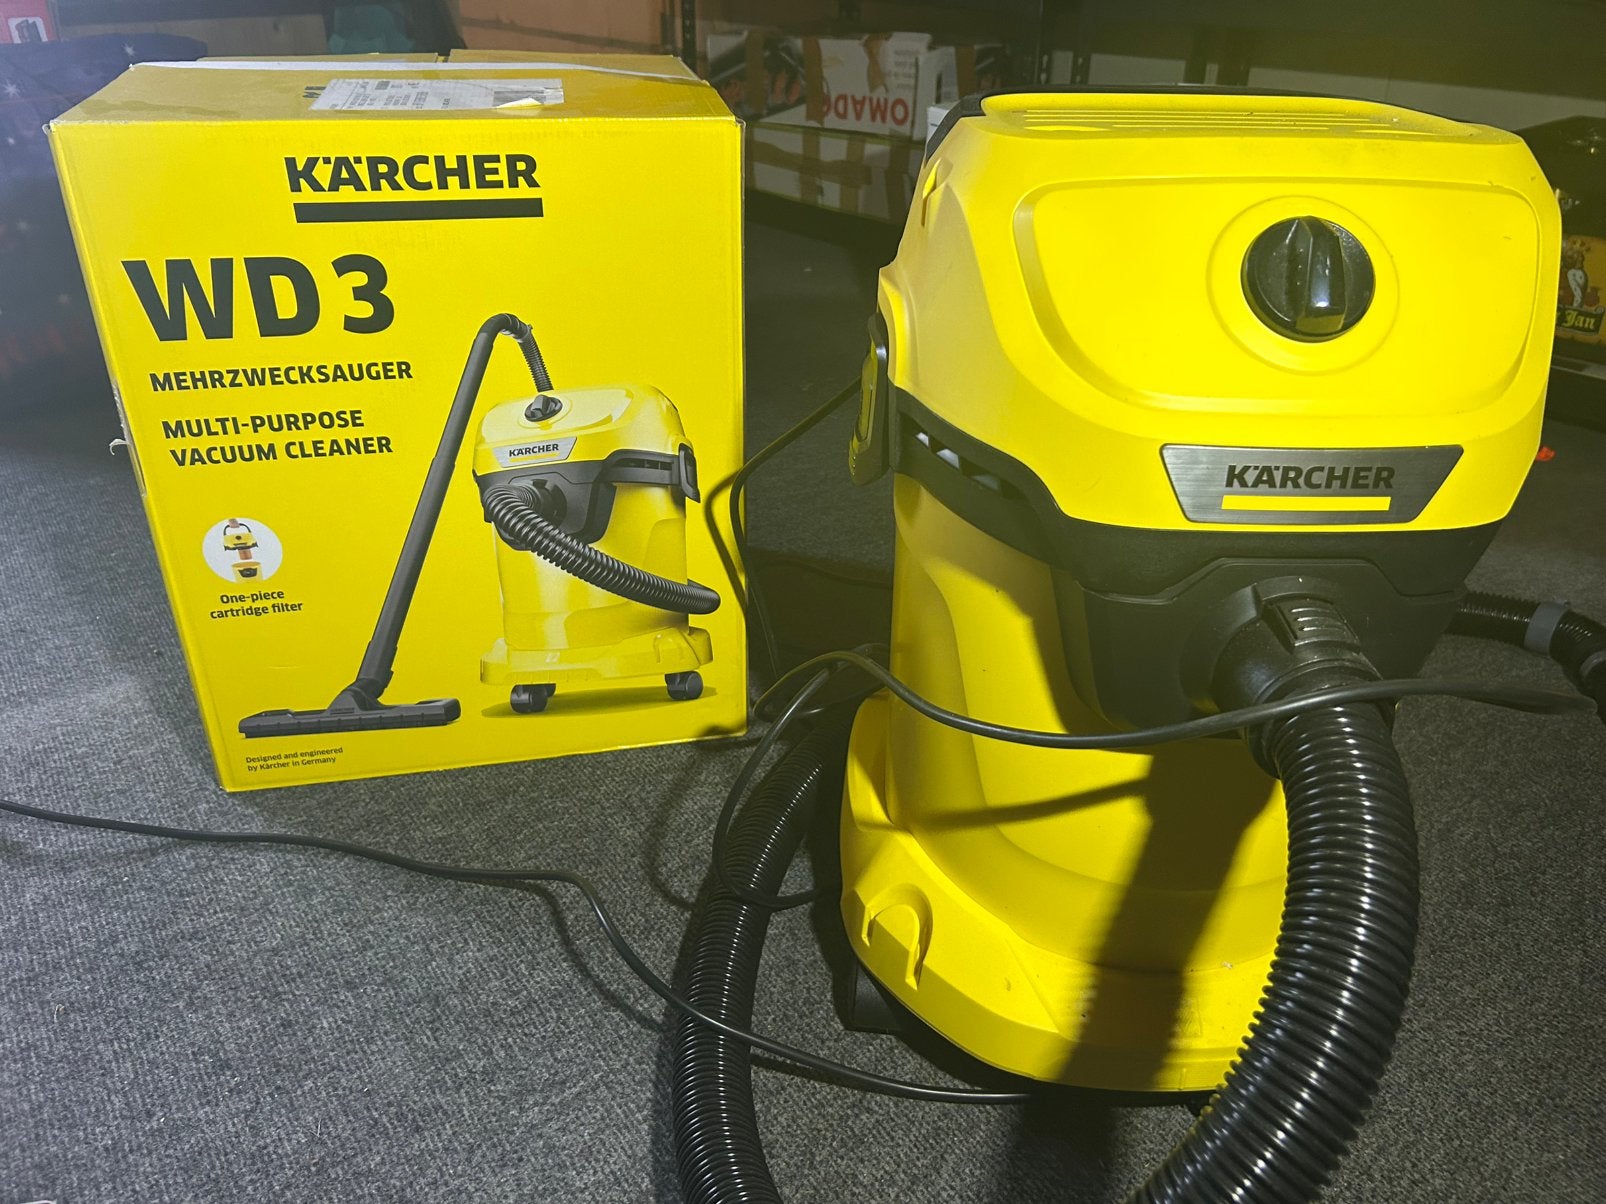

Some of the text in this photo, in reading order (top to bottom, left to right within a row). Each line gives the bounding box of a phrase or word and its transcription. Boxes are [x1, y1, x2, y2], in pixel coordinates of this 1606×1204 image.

[285, 154, 540, 193] KÄRCHER
[121, 253, 395, 342] WD 3
[1562, 310, 1595, 329] Jan
[149, 361, 413, 392] MEHRZWECKSAUGER
[162, 409, 365, 439] MULTI-PURPOSE
[170, 436, 393, 467] VACUUM CLEANER
[509, 443, 559, 457] KÄRCHER
[1225, 463, 1395, 491] KÄRCHER
[220, 591, 285, 604] One-piece
[210, 602, 303, 619] cartridge filter
[245, 747, 343, 763] Designed and engineered
[260, 761, 289, 769] Kärcher
[301, 757, 336, 766] Germany
